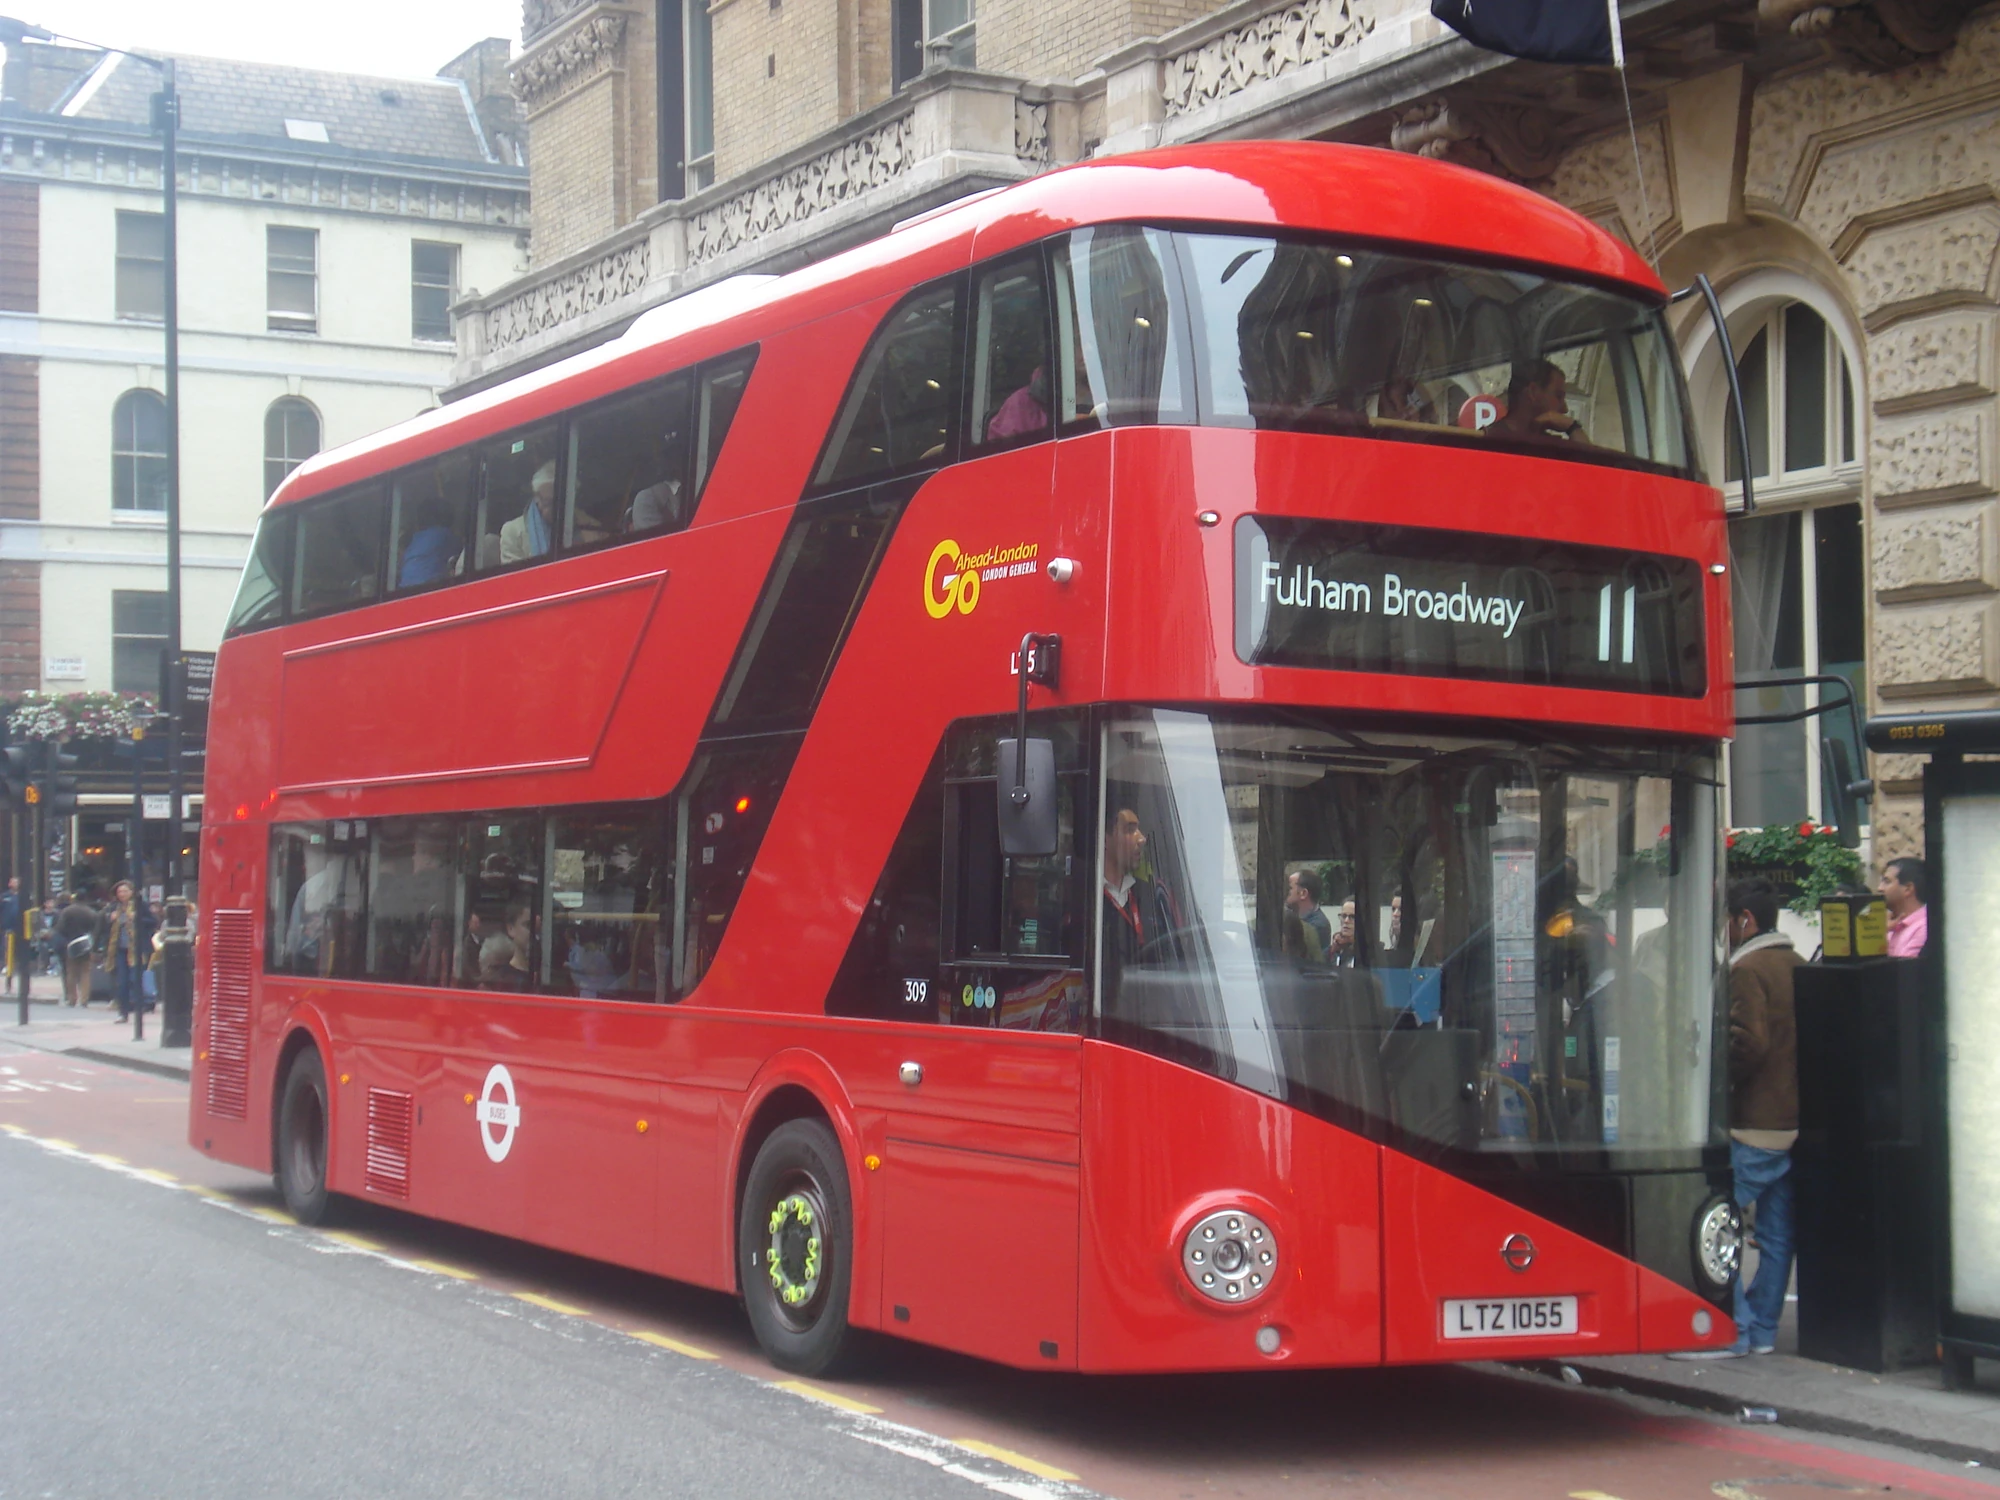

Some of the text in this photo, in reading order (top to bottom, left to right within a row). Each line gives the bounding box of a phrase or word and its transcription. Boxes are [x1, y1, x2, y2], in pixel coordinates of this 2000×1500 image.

[924, 539, 1038, 619] Go Ahead-London
[982, 560, 1037, 582] LONDON GENERAL
[1261, 561, 1525, 639] Fulham Broadway
[1598, 583, 1635, 663] 11
[905, 981, 927, 1003] 309
[490, 1107, 506, 1120] BUSES
[1460, 1302, 1562, 1331] LTZ 1055
